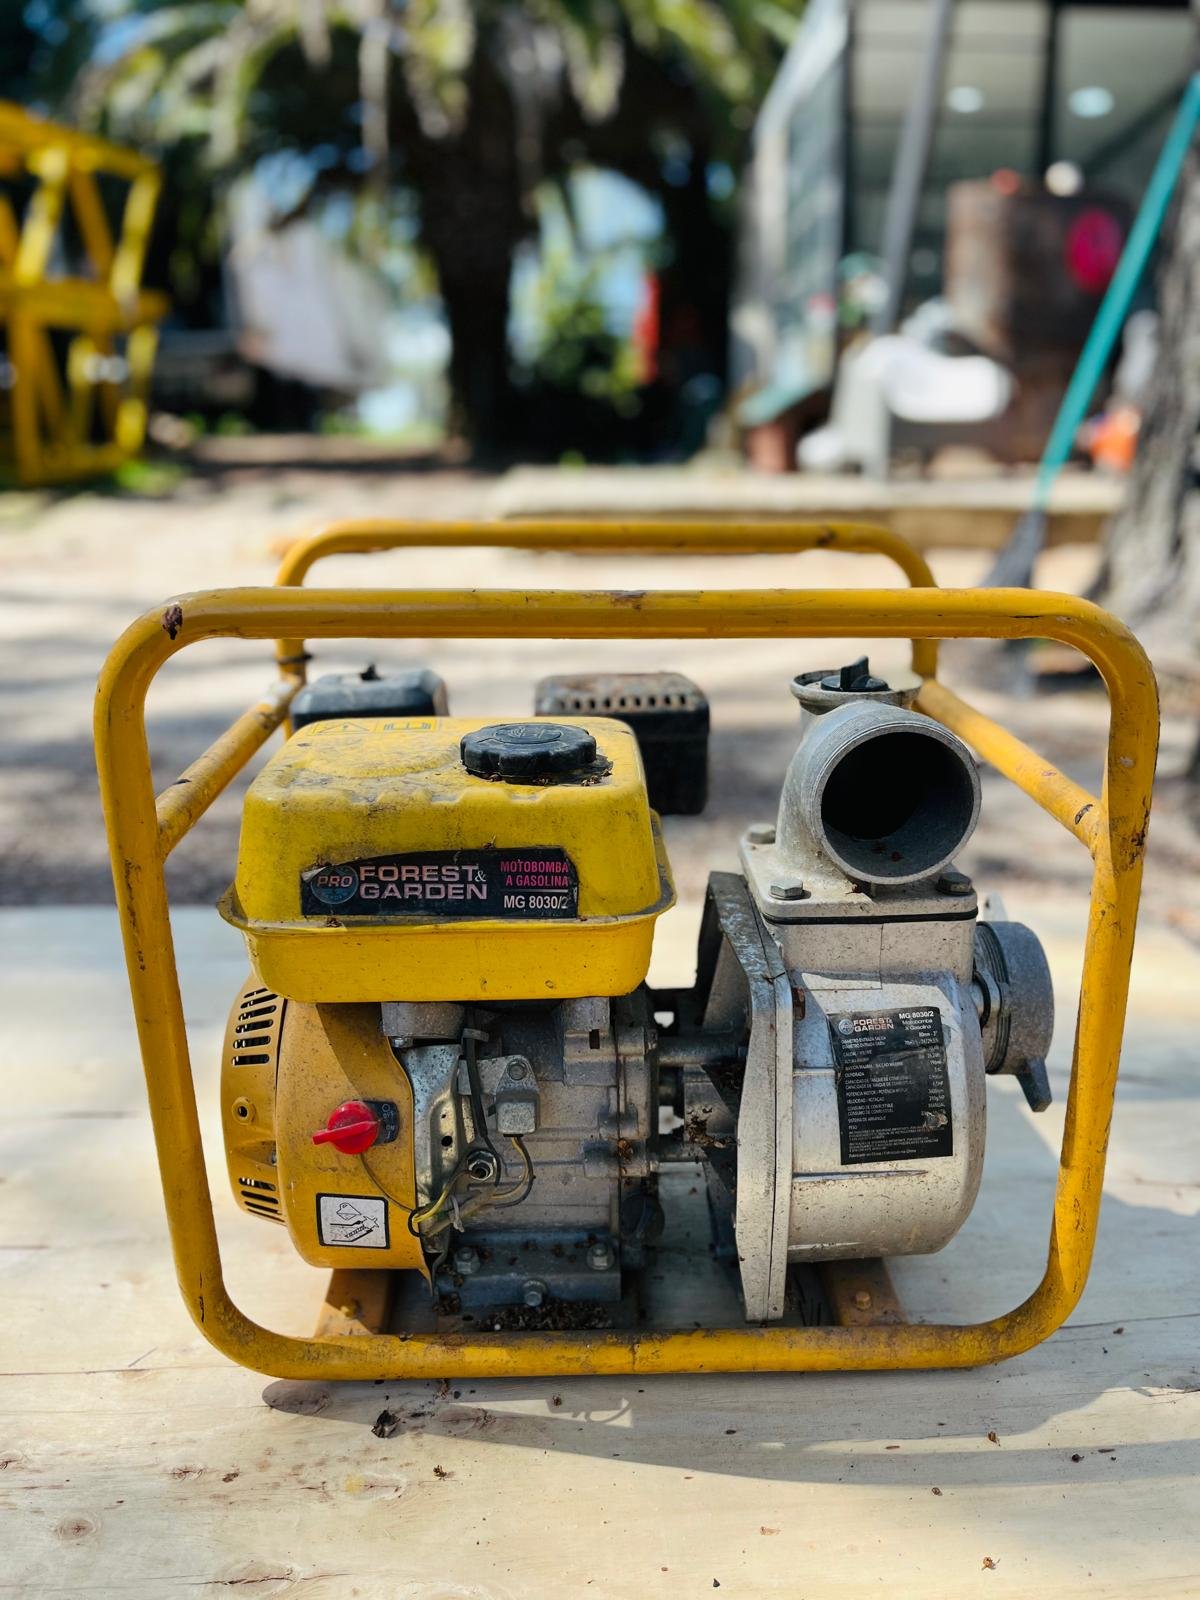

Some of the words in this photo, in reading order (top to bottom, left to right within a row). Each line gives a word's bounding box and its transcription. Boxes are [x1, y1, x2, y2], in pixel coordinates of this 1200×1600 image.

[360, 865, 479, 881] FOREST
[500, 861, 569, 873] MOTOBOMBA
[317, 875, 353, 888] PRO
[506, 875, 514, 887] A
[516, 875, 569, 887] GASOLINA
[360, 883, 488, 899] GARDEN
[504, 895, 526, 909] MG
[528, 895, 568, 910] 8030/2
[854, 1023, 894, 1032] GARDEN
